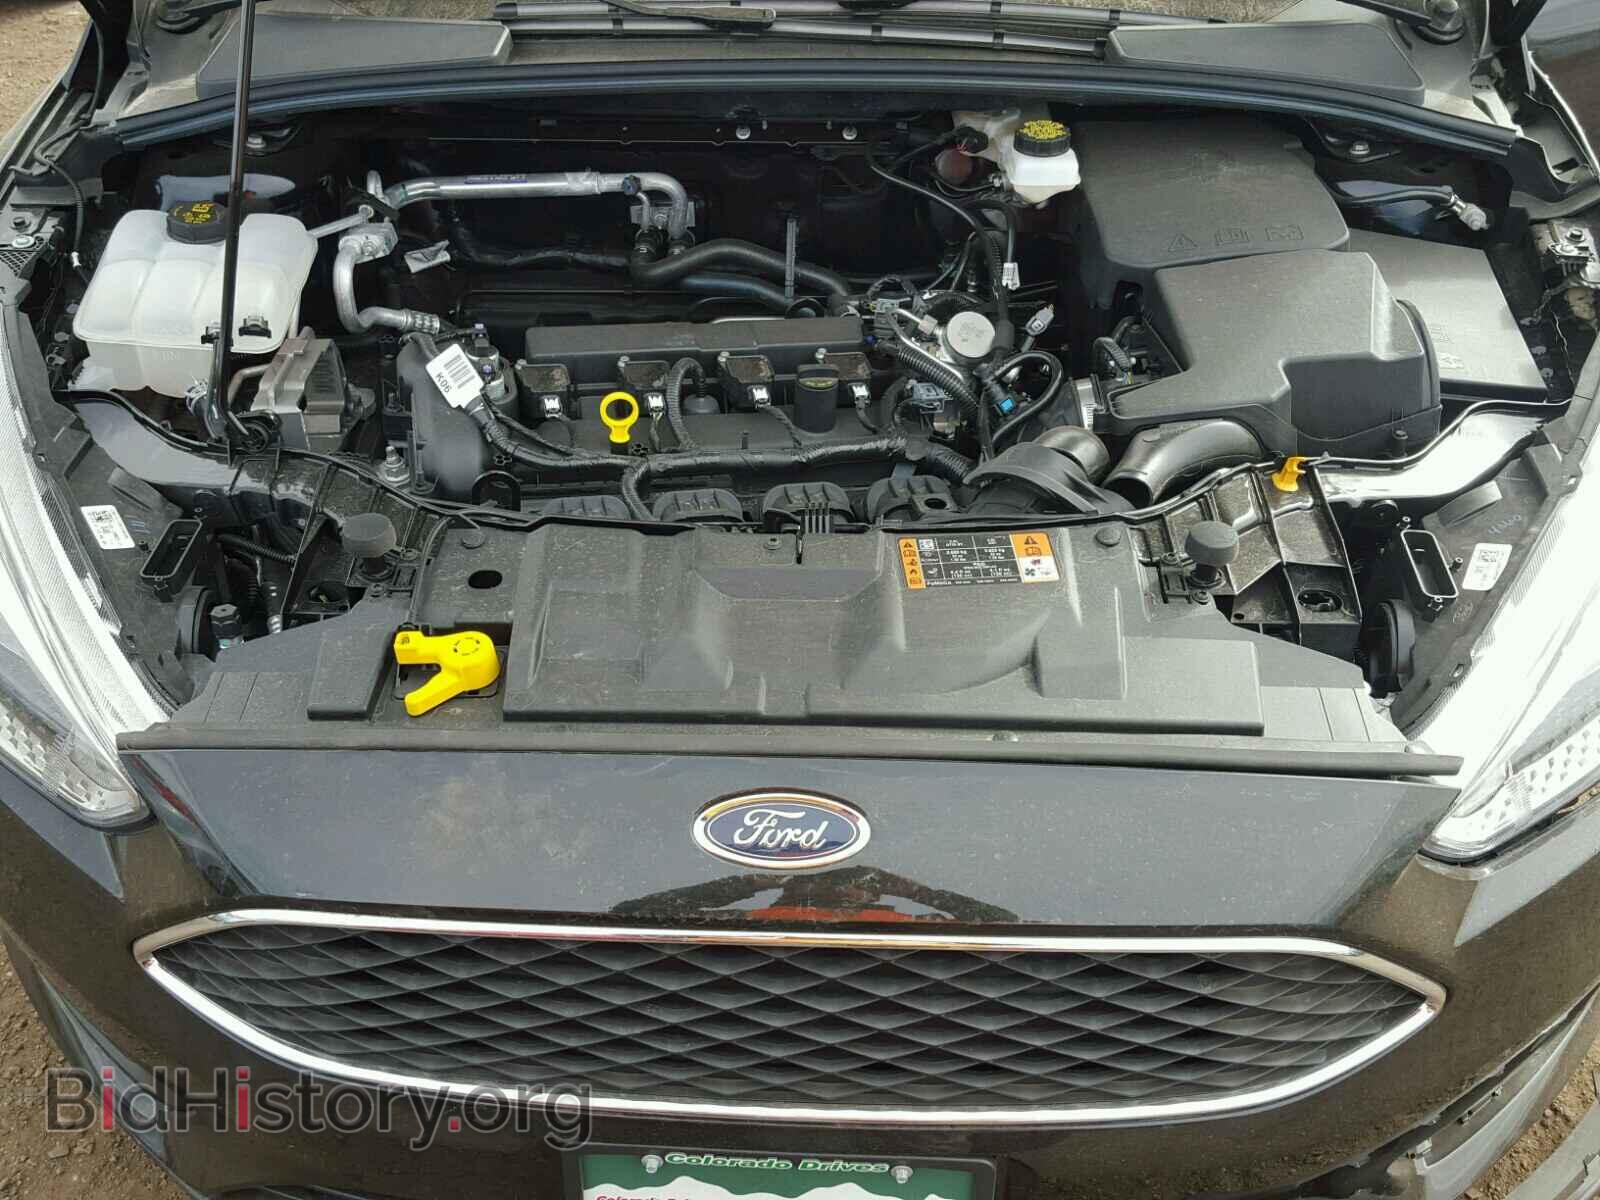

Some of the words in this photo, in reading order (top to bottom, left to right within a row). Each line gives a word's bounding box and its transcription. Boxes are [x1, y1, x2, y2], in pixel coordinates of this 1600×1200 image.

[436, 372, 452, 393] K06
[733, 808, 829, 848] Ford
[664, 1152, 793, 1169] Colorado
[798, 1160, 889, 1174] Drives
